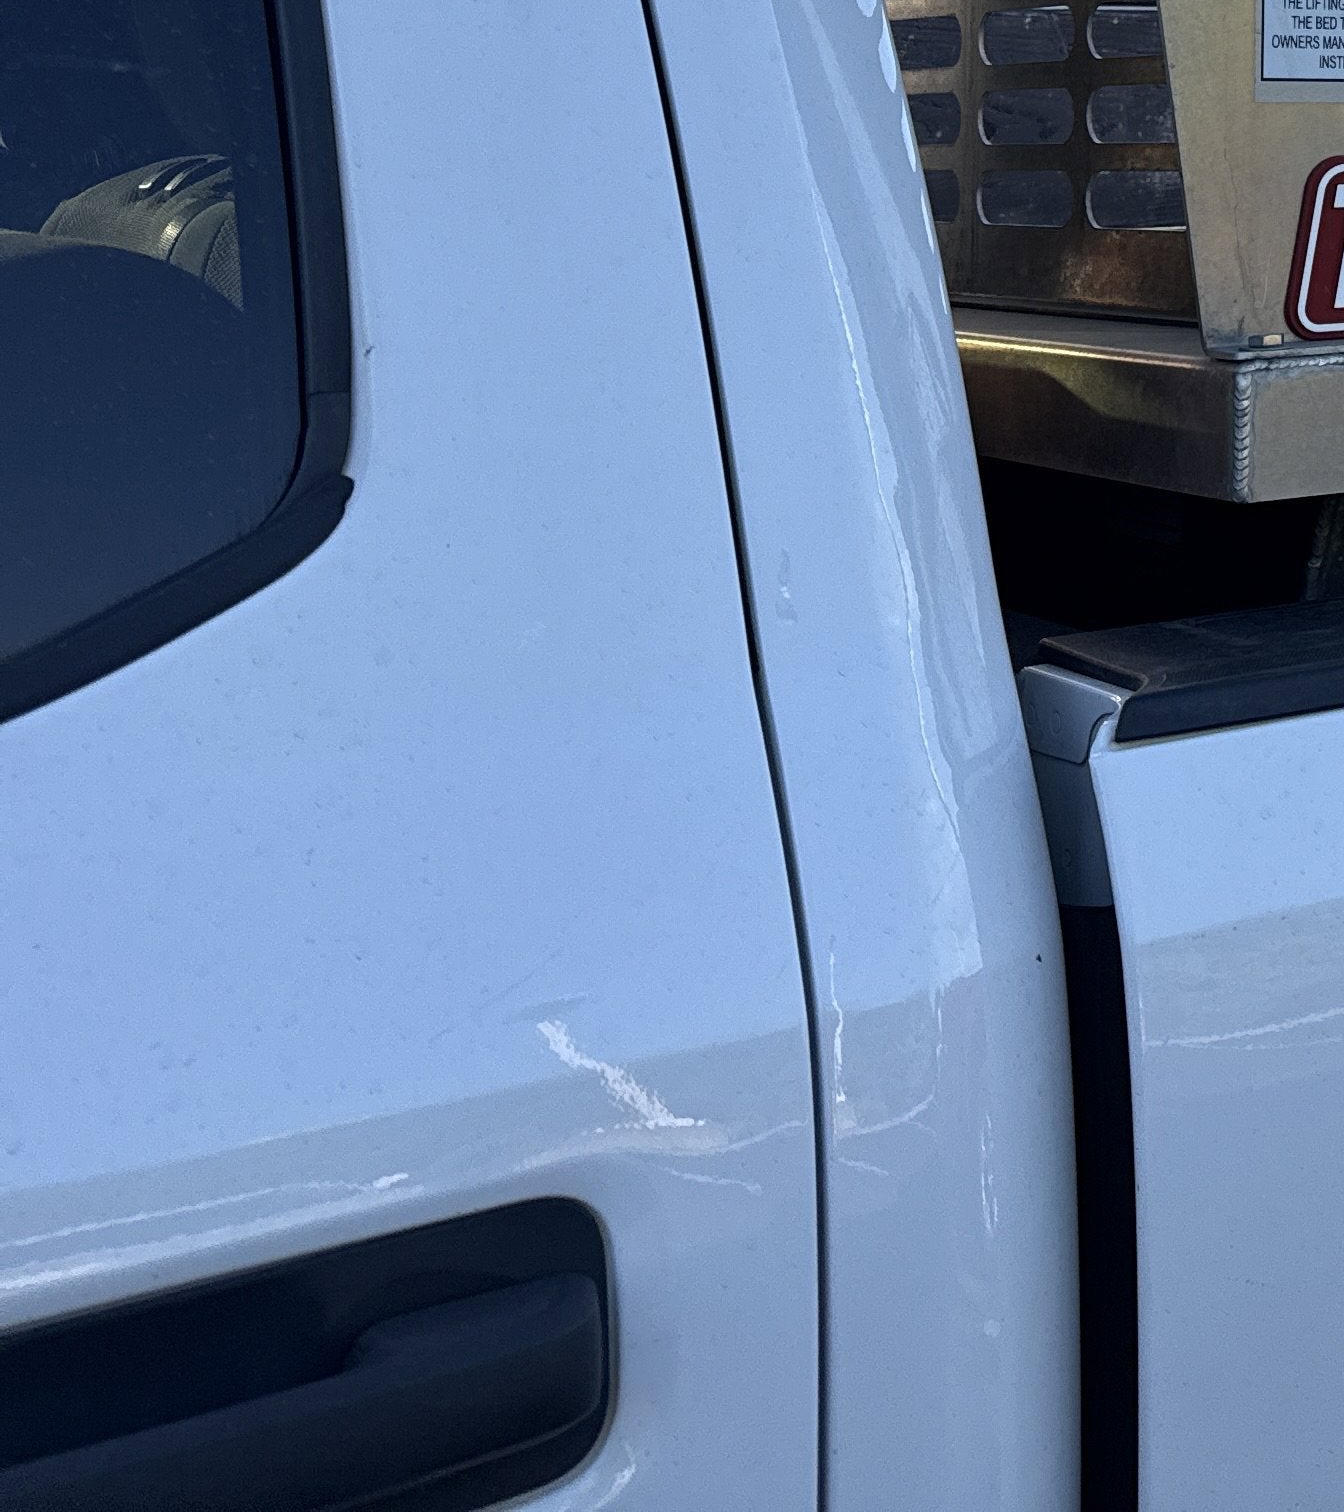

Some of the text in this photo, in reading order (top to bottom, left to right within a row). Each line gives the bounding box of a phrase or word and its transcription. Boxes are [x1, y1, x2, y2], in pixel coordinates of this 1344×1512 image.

[1291, 15, 1312, 30] THE
[1316, 16, 1337, 30] BED
[1272, 35, 1320, 49] OWNERS
